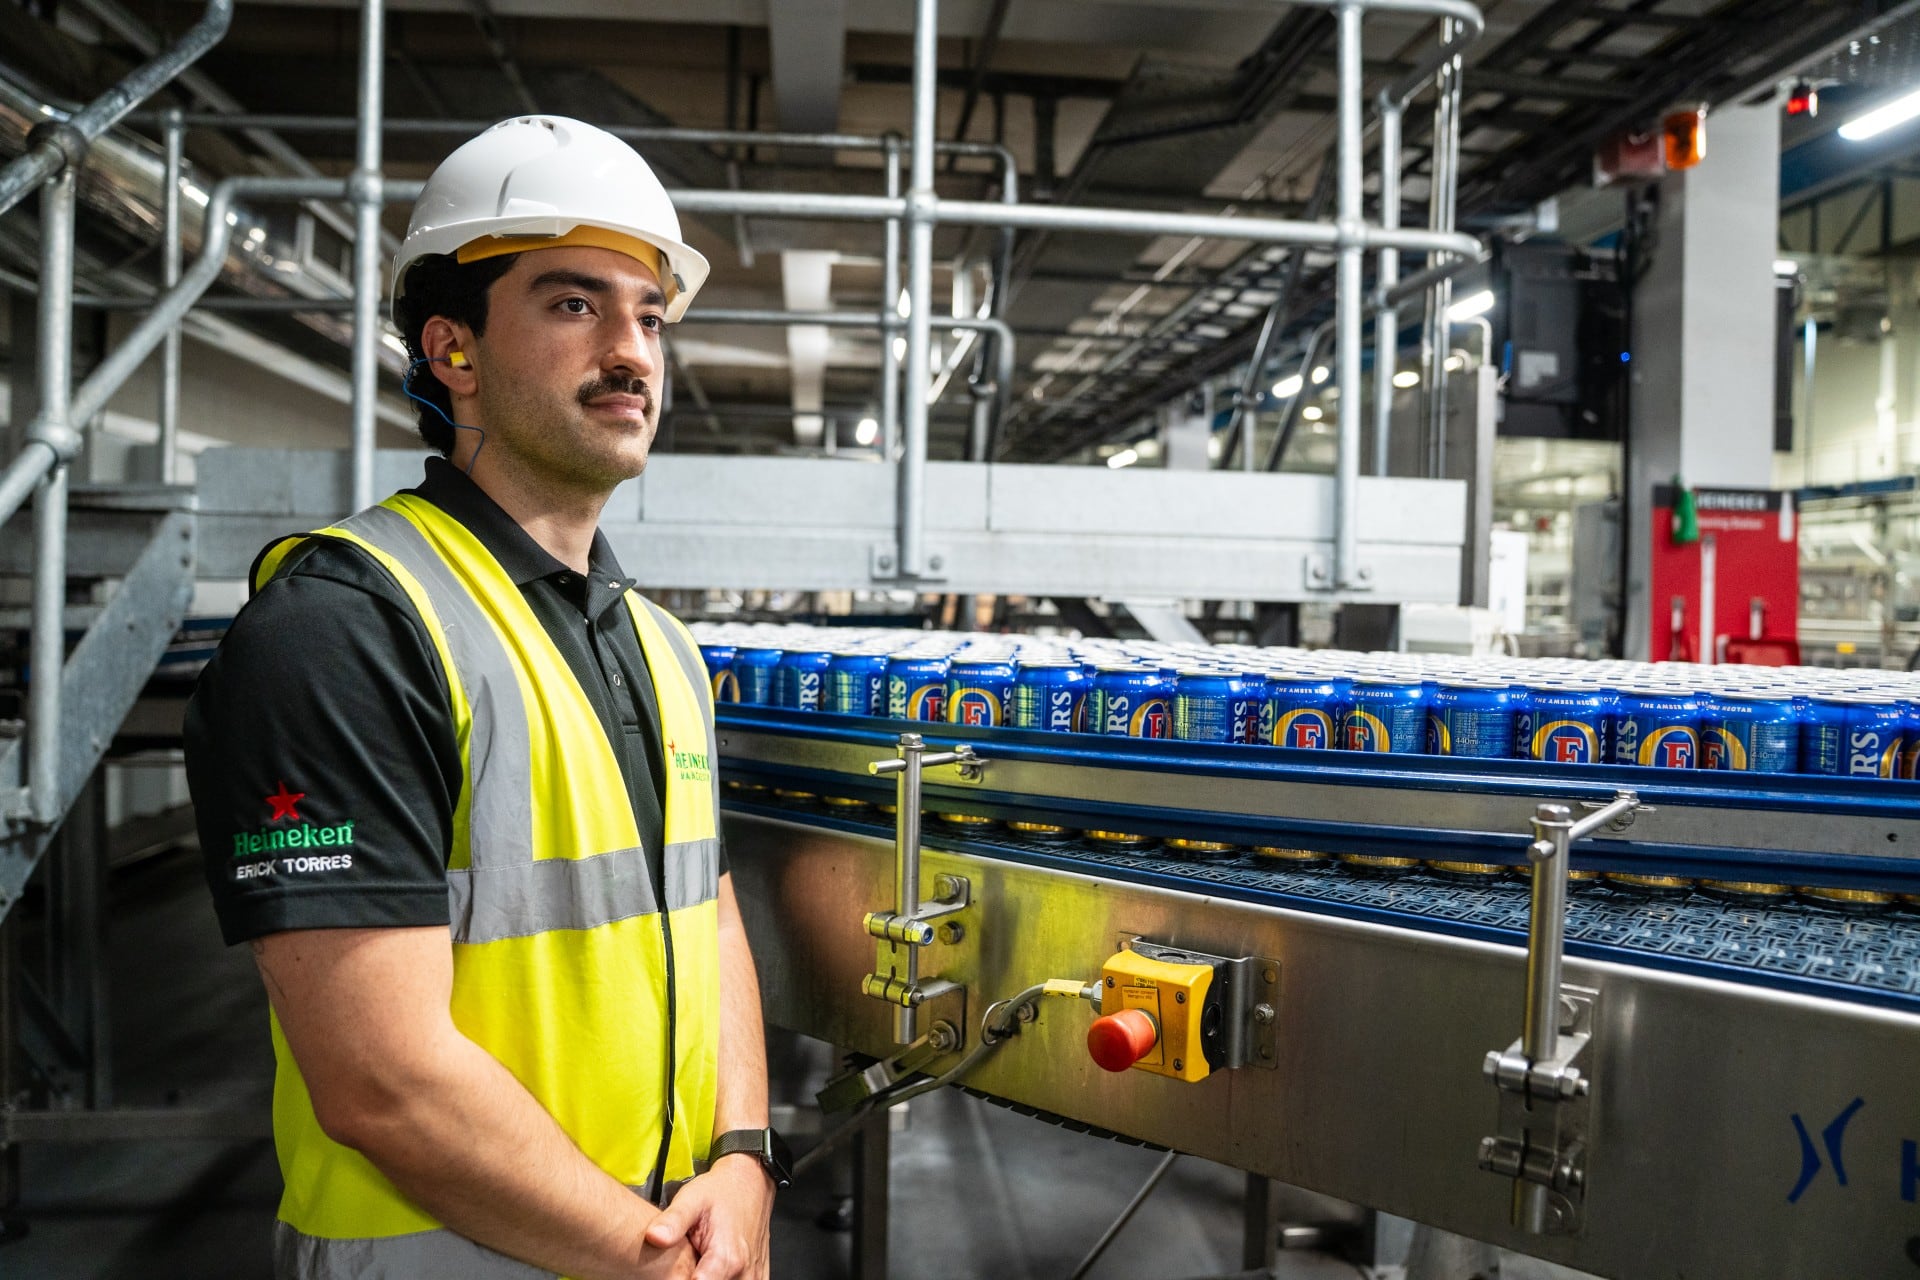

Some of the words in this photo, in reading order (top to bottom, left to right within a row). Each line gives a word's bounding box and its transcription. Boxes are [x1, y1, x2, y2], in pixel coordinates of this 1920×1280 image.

[1366, 690, 1394, 699] NECTAR
[1548, 698, 1575, 706] AMBER
[1639, 702, 1655, 710] THE
[1051, 690, 1072, 732] R'S
[1294, 723, 1321, 749] F
[1553, 736, 1584, 764] F
[1663, 742, 1691, 769] F
[233, 823, 354, 857] Heineken
[236, 859, 277, 880] ERICK
[283, 854, 353, 874] TORRES
